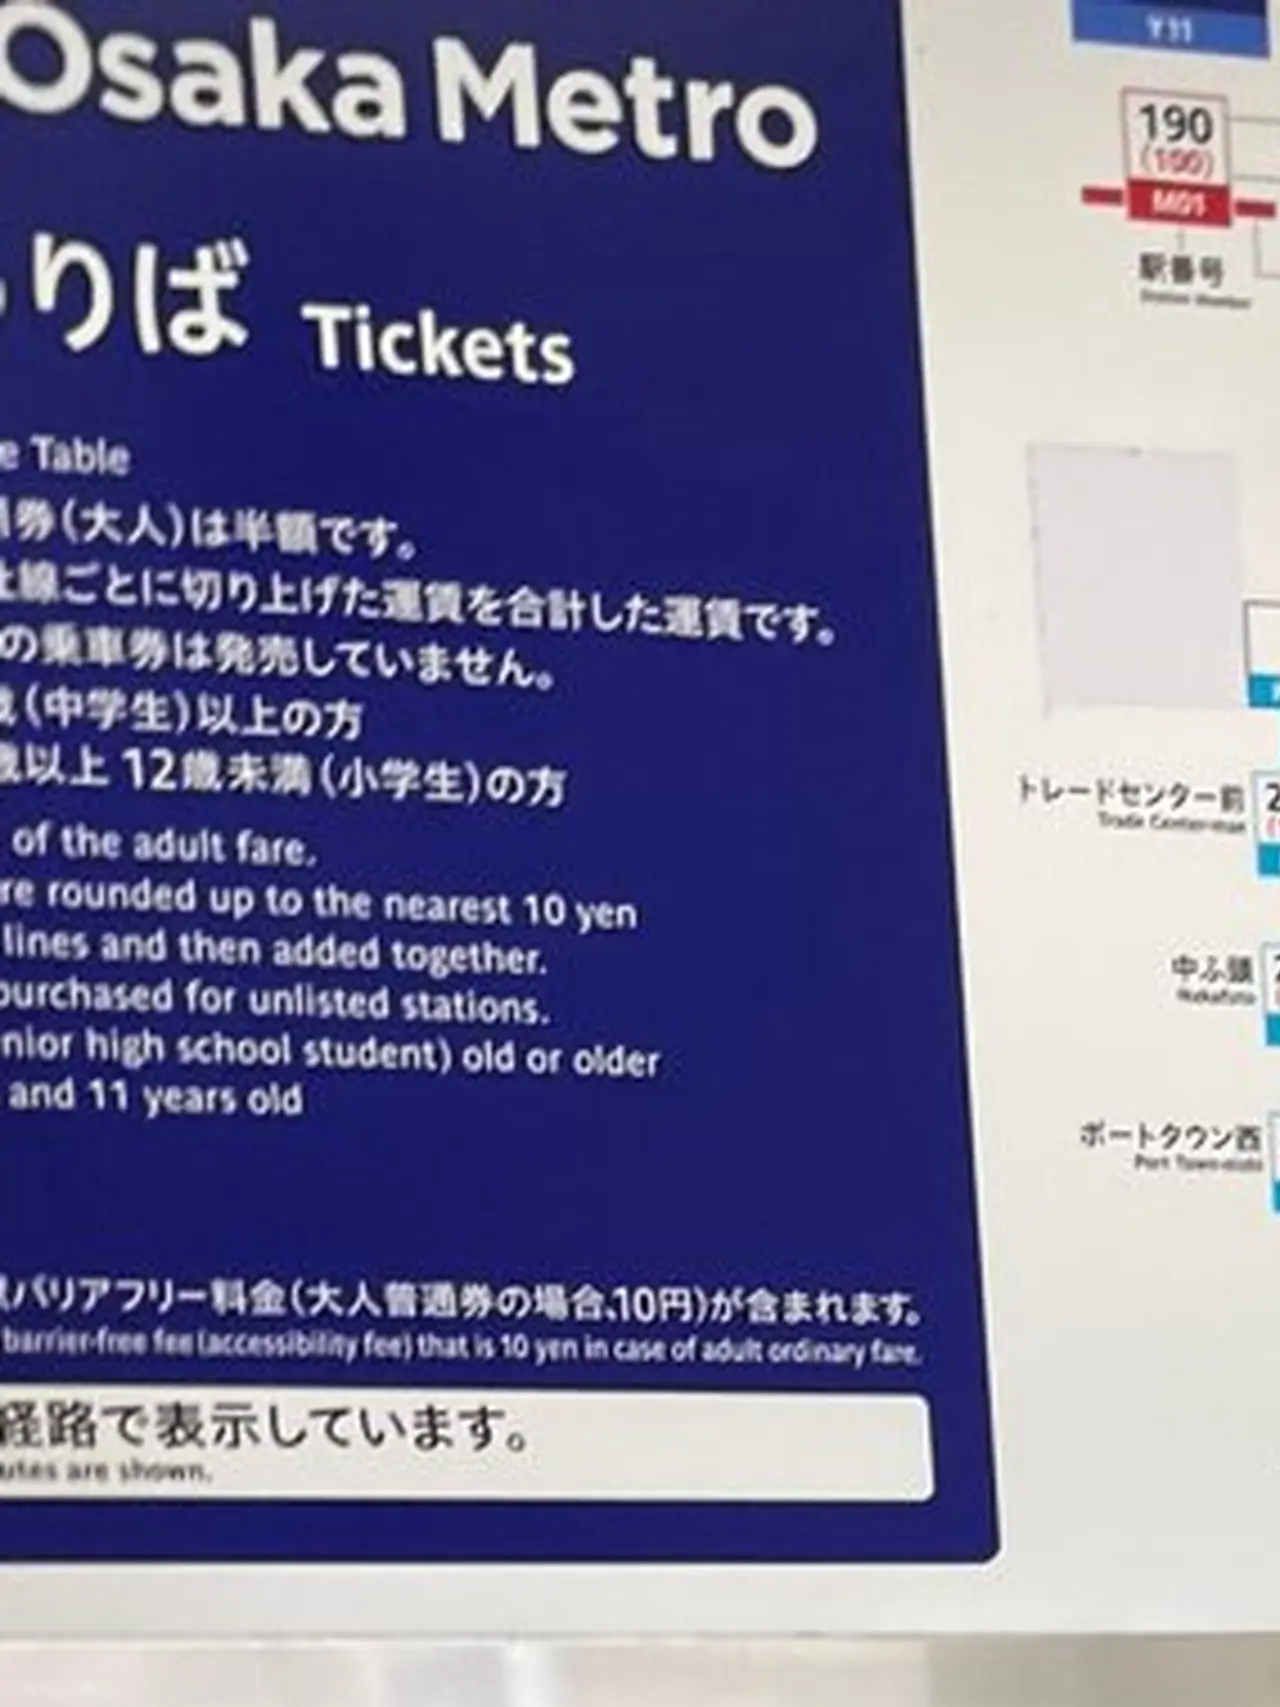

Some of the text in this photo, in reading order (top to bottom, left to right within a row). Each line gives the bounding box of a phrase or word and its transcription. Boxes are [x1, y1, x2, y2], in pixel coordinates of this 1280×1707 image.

[0, 2, 819, 169] Osaka Metro
[1139, 104, 1213, 145] 190
[0, 231, 575, 386] りば Tickets
[31, 434, 130, 475] Table
[12, 821, 51, 857] of
[61, 822, 121, 859] the
[133, 828, 226, 863] adult
[48, 876, 637, 935] rounded up to the nearest 10 yen
[3, 922, 548, 979] lines and then added together.
[185, 979, 235, 1014] for
[250, 982, 389, 1019] unlisted
[401, 991, 550, 1026] stations.
[85, 1026, 164, 1069] high
[176, 1031, 291, 1065] school
[304, 1036, 452, 1074] student)
[462, 1041, 515, 1072] old
[526, 1049, 562, 1073] or
[574, 1044, 661, 1078] older
[9, 1076, 303, 1119] and 11 years old
[5, 1327, 148, 1355] barrier-free
[417, 1334, 470, 1358] that
[476, 1335, 495, 1359] is
[501, 1334, 529, 1359] 10
[535, 1339, 578, 1366] yen
[584, 1336, 609, 1359] in
[613, 1340, 666, 1362] case
[671, 1337, 698, 1362] of
[66, 1464, 108, 1481] are
